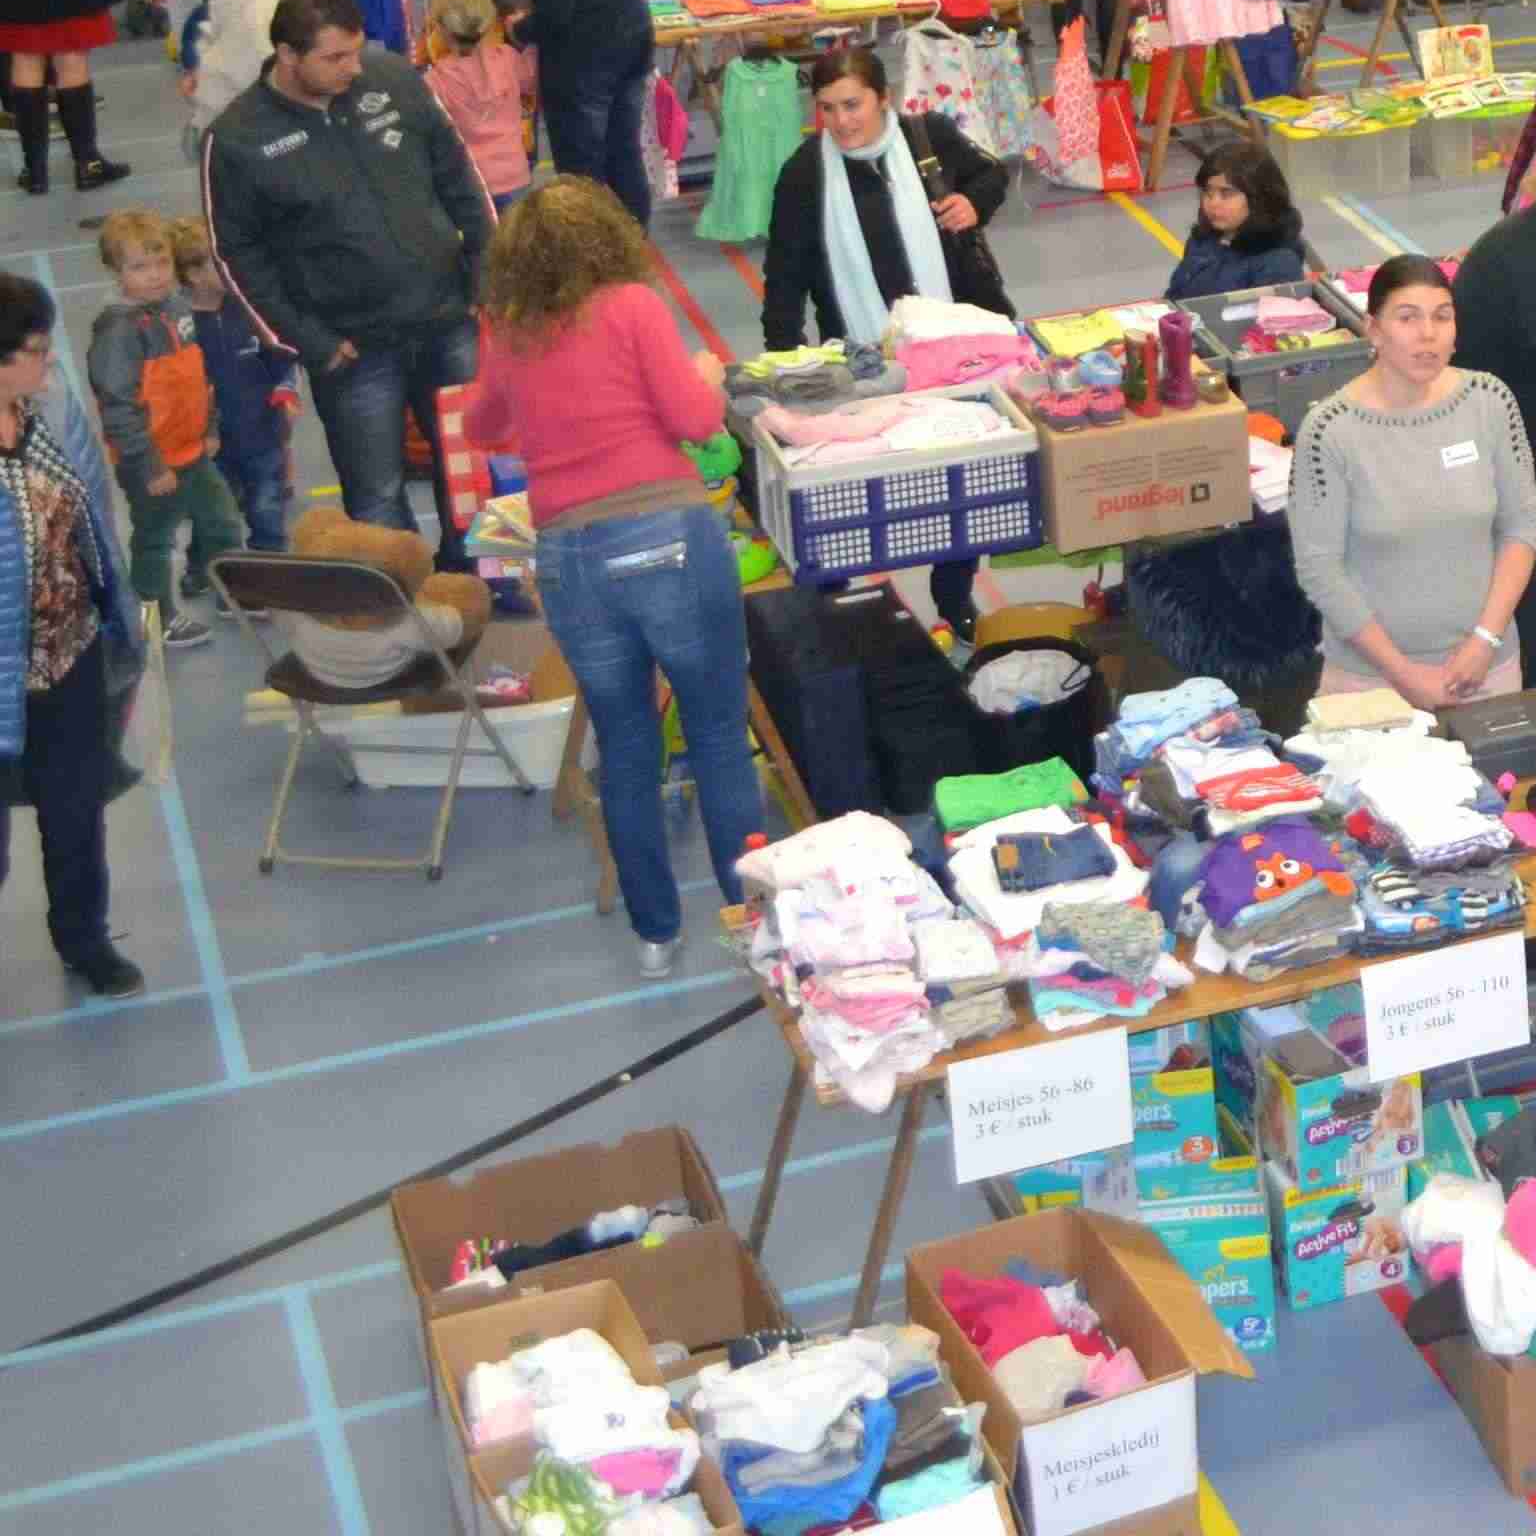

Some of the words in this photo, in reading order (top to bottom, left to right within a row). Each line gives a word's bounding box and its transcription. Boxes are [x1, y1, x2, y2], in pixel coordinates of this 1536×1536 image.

[1095, 481, 1186, 520] legrand
[1380, 992, 1442, 1022] Jongens
[1446, 986, 1465, 1003] 56
[1480, 974, 1511, 994] 110
[1384, 1024, 1396, 1041] 3
[1423, 1011, 1456, 1031] stuk
[967, 1090, 1034, 1119] Meisjes
[1039, 1084, 1061, 1103] 56
[974, 1122, 986, 1140] 3
[988, 1119, 1002, 1136] €
[1017, 1107, 1054, 1130] stuk
[1043, 1425, 1161, 1479] Meisjeskledij
[1052, 1484, 1061, 1502] 1
[1065, 1479, 1080, 1496] €
[1094, 1463, 1131, 1487] stuk
